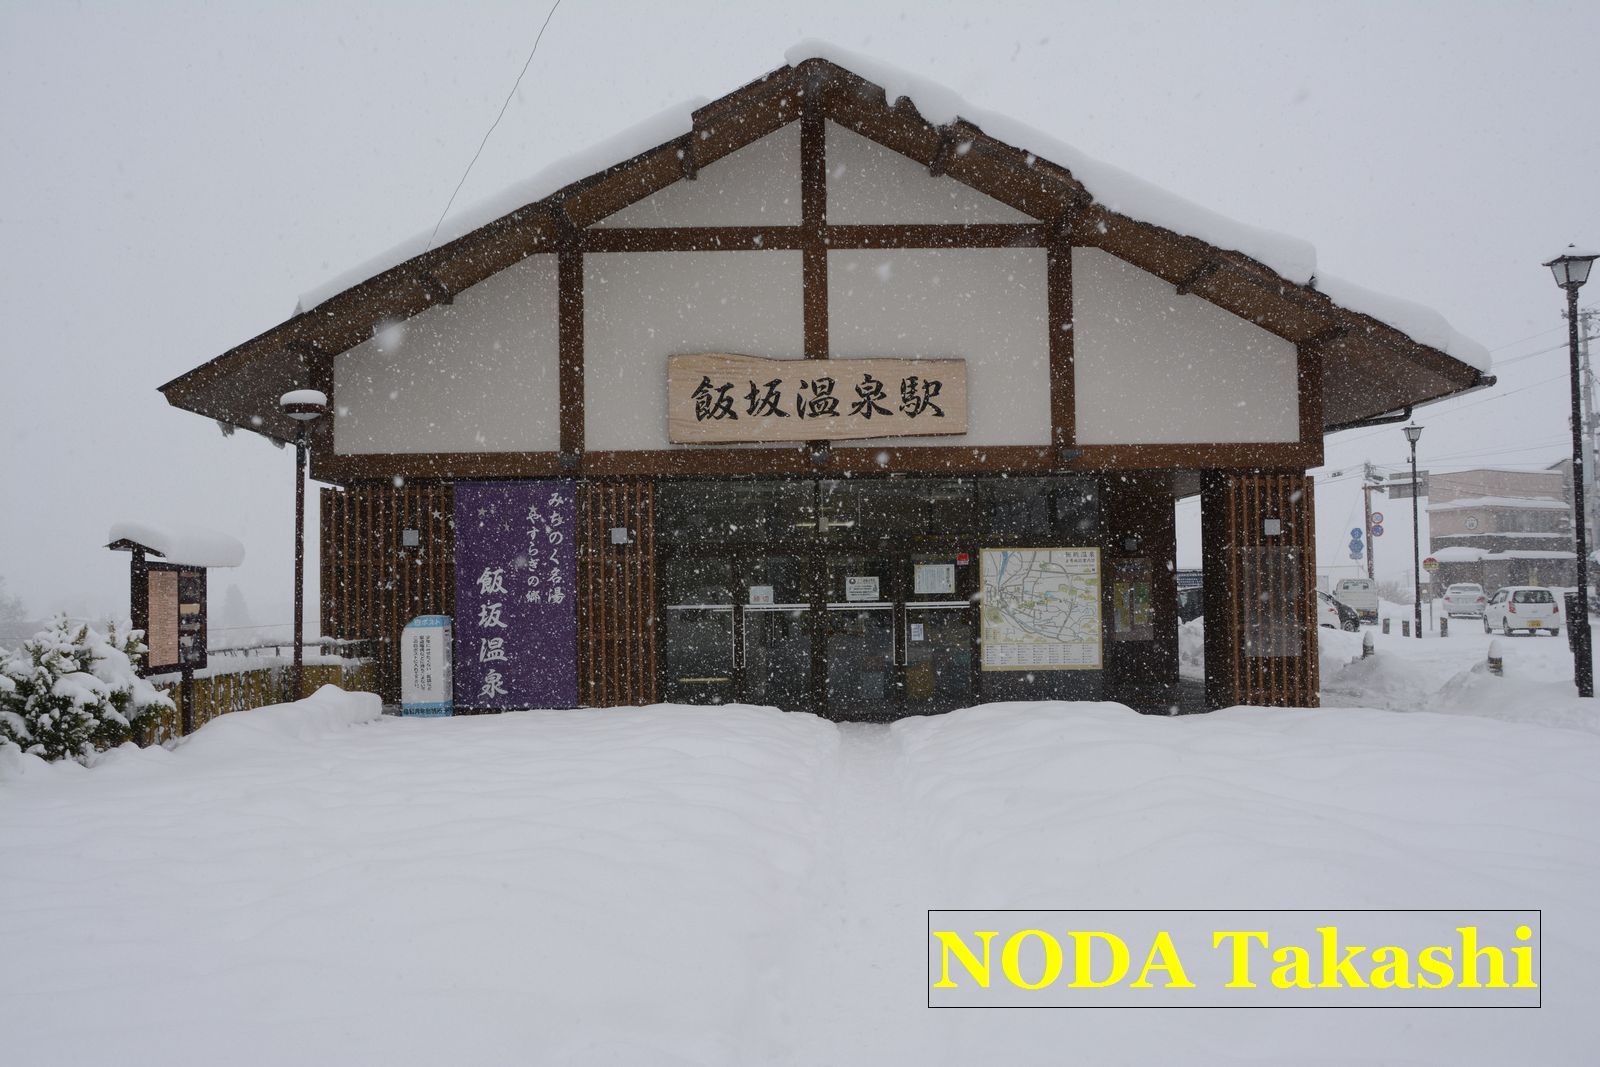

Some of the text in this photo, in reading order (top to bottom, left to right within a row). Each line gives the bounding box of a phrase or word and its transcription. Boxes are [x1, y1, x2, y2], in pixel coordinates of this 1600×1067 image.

[690, 373, 945, 422] 飯坂温泉駅
[525, 510, 543, 604] やすらぎの郷
[547, 492, 567, 605] みちのく名湯
[477, 566, 509, 699] 飯坂温泉
